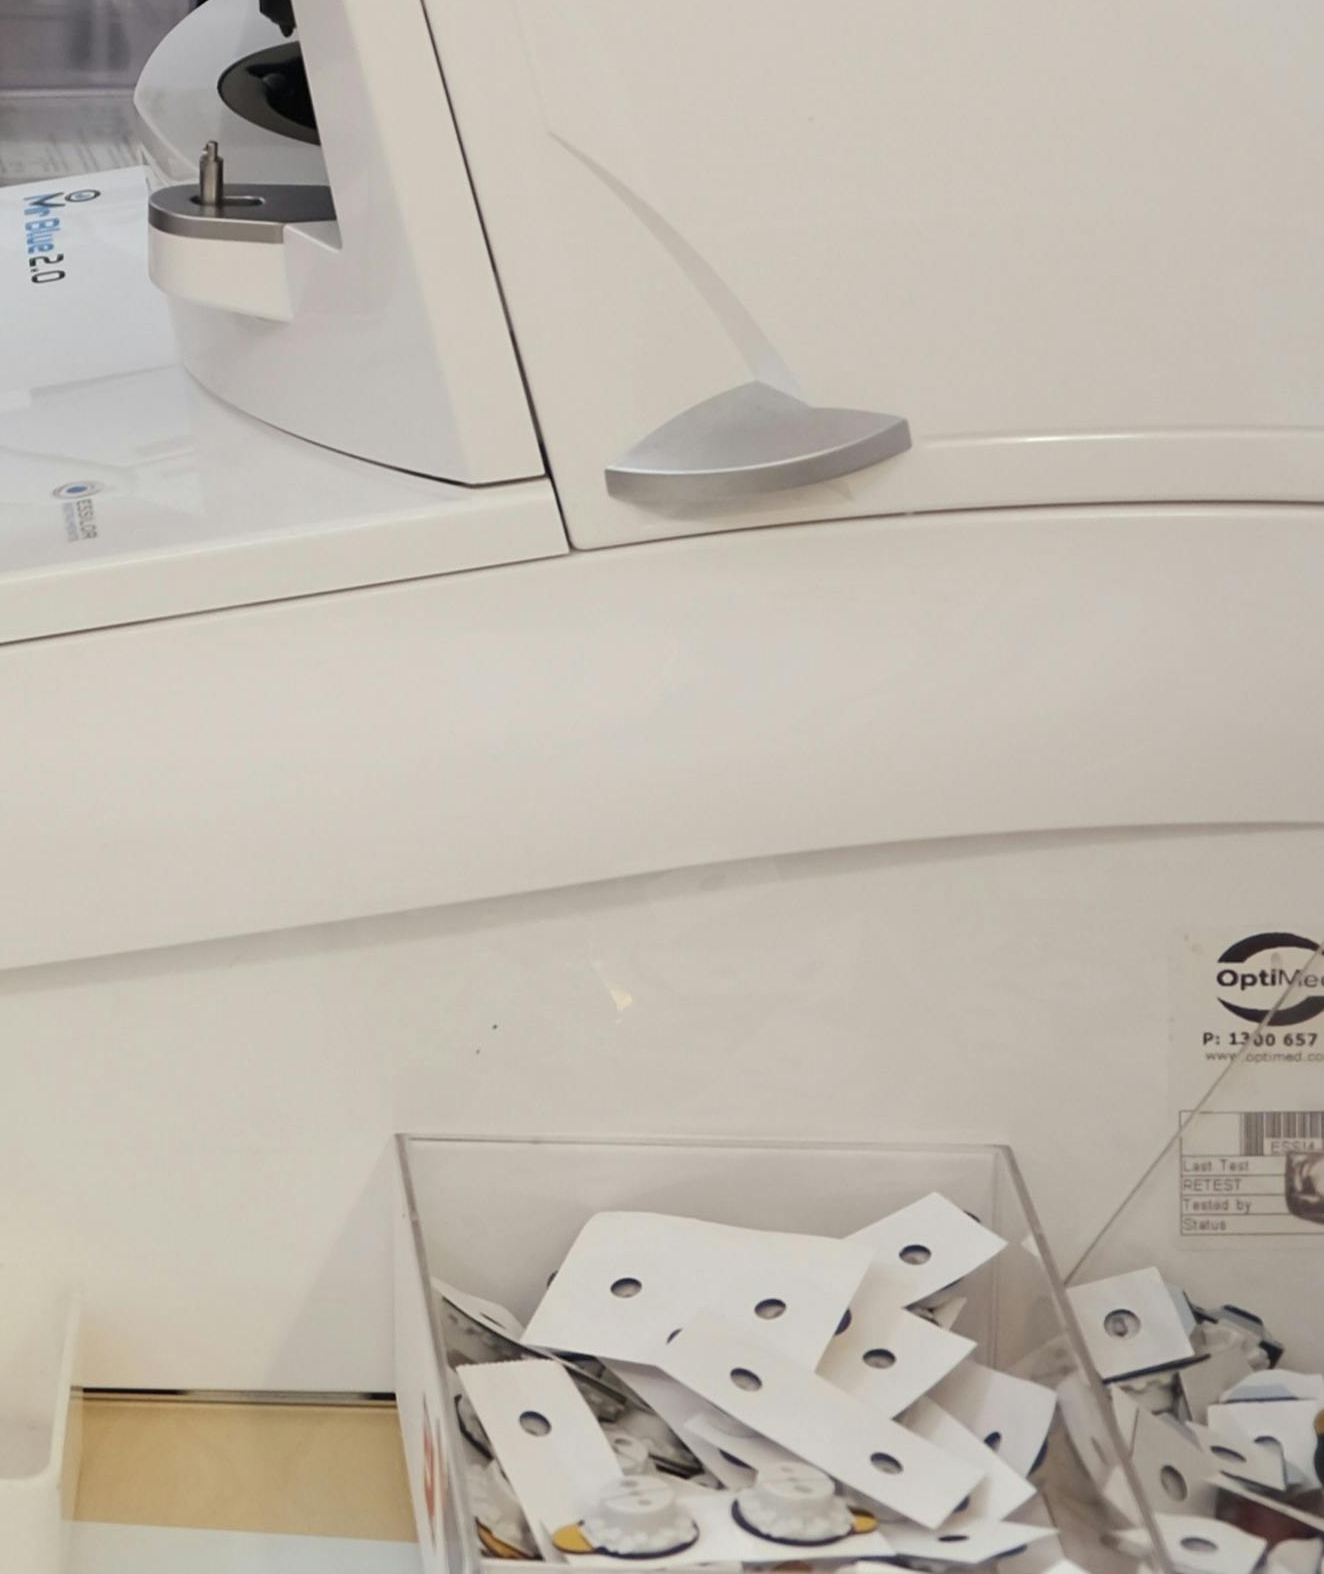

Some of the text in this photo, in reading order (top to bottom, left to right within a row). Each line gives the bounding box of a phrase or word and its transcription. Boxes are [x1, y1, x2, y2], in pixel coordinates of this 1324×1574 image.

[25, 218, 61, 254] Blue
[29, 253, 66, 284] 2.0
[1202, 1031, 1221, 1046] P:
[1283, 1032, 1319, 1048] 657
[1182, 1158, 1250, 1173] Last Test
[1182, 1178, 1243, 1192] RETEST
[1182, 1198, 1254, 1214] Tested by
[1182, 1217, 1227, 1231] Status
